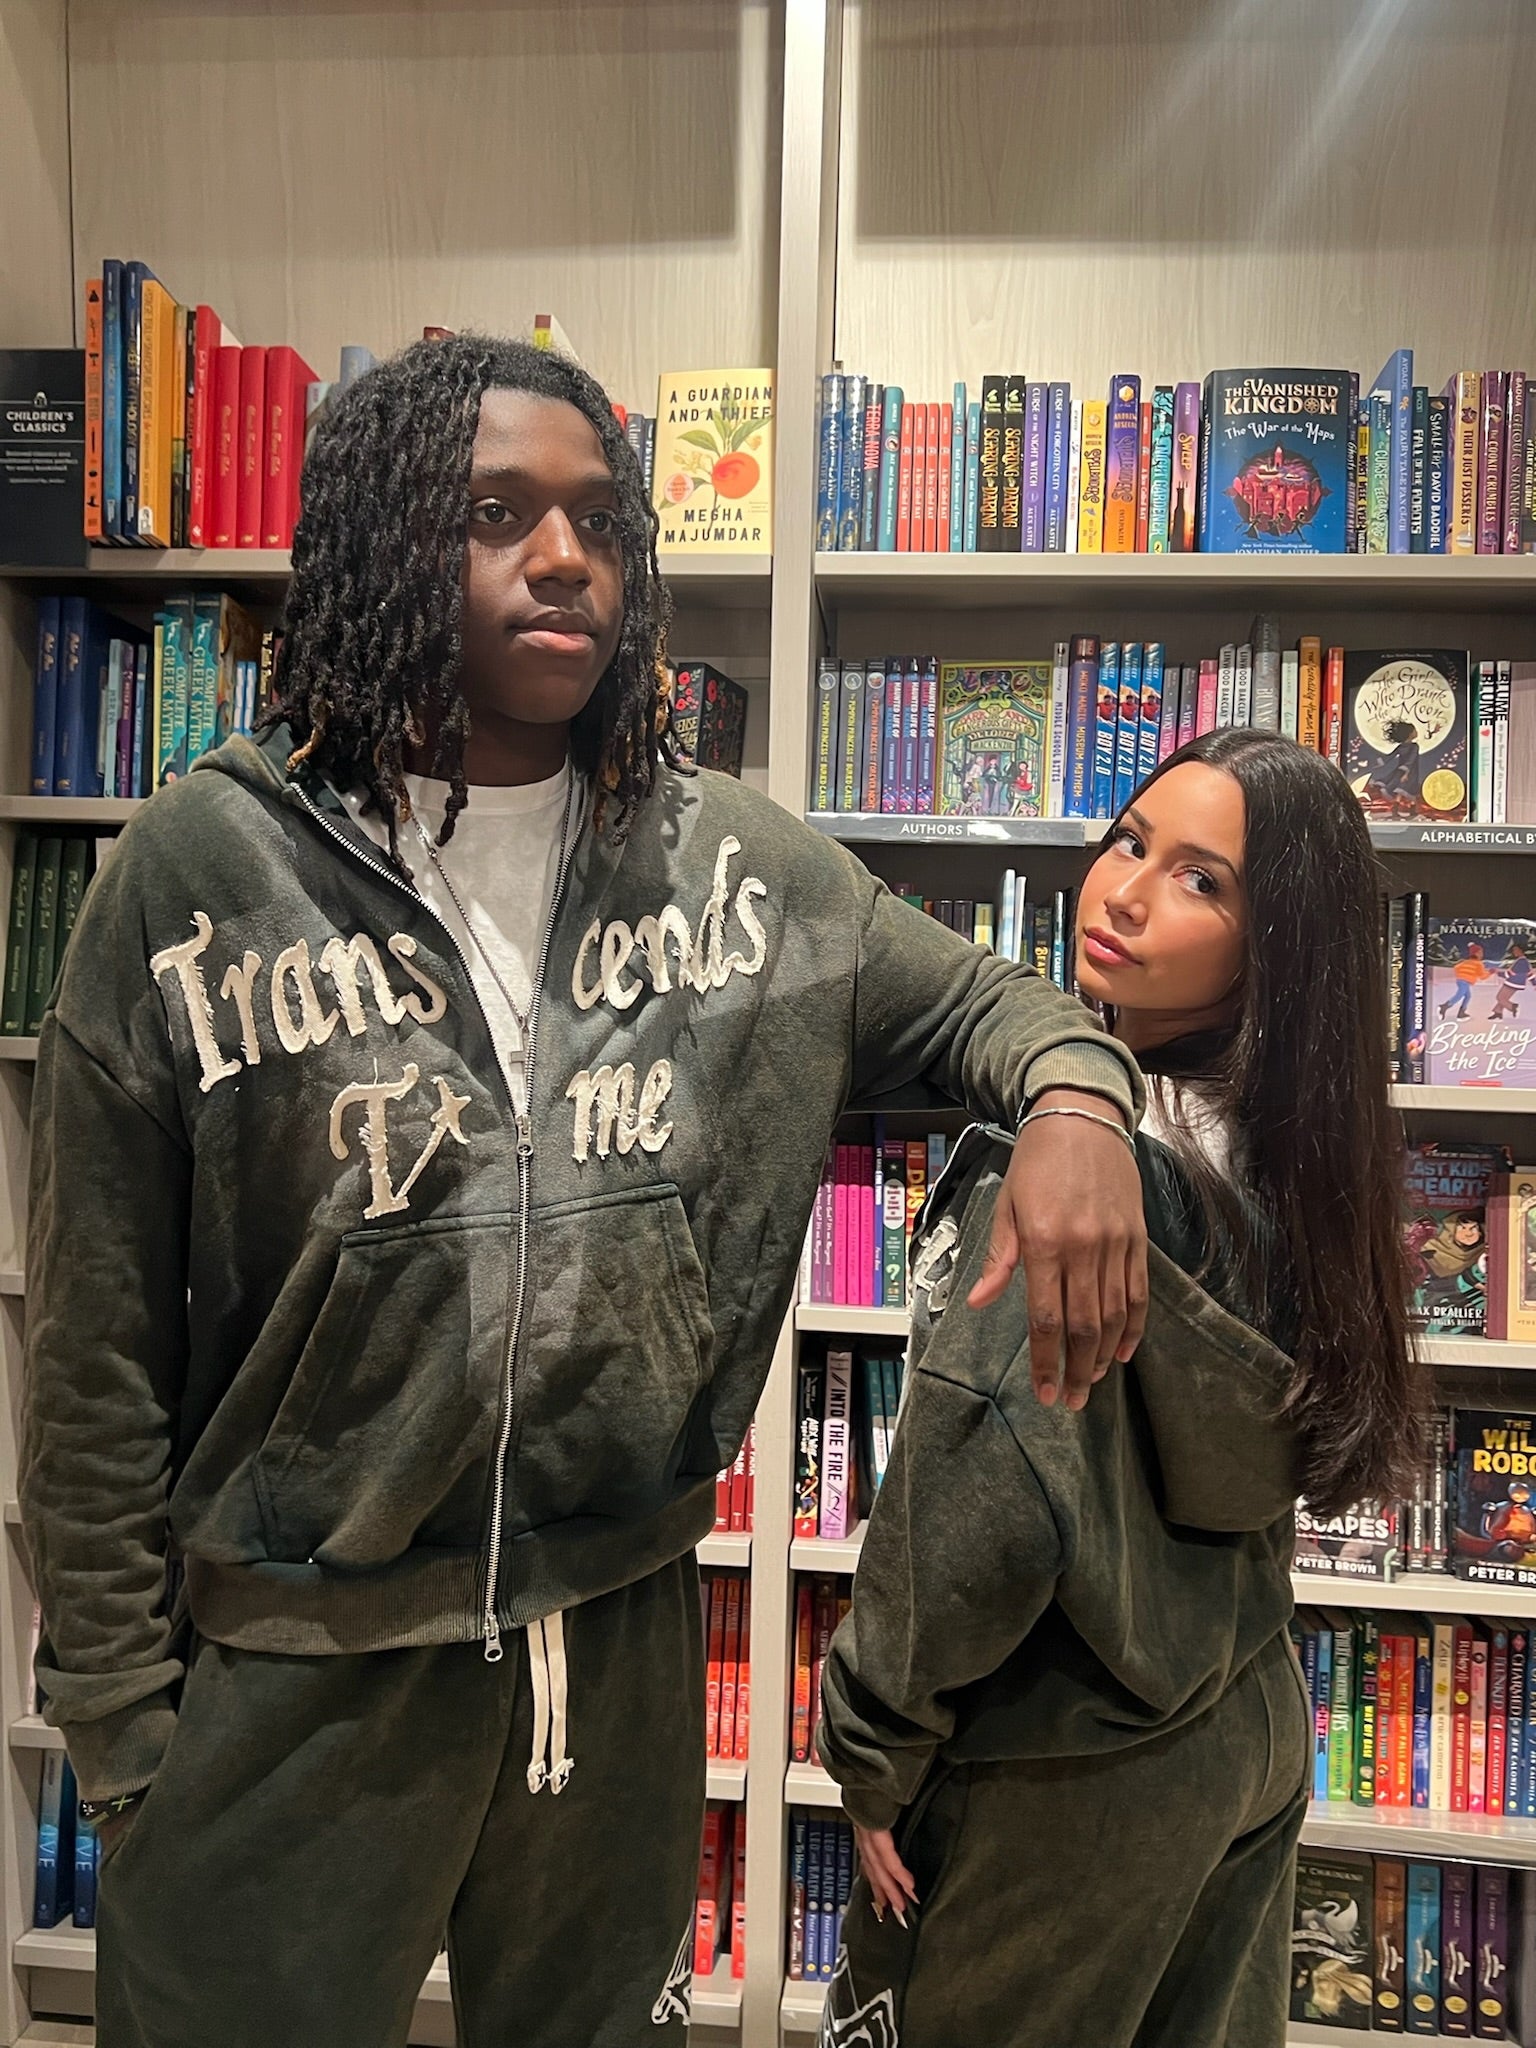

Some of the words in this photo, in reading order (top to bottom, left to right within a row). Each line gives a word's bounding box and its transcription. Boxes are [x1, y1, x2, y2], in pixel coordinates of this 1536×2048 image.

[670, 391, 677, 403] A
[688, 387, 772, 402] GUARDIAN
[1031, 387, 1040, 413] CURSE
[1054, 389, 1063, 411] CURSE
[1224, 387, 1250, 397] THE
[1244, 379, 1339, 397] VANISHED
[6, 411, 74, 421] CHILDREN'S
[669, 409, 699, 423] AND
[706, 408, 715, 421] A
[721, 407, 771, 421] THIEF
[1224, 397, 1337, 415] KINGDOM
[13, 423, 67, 432] CLASSICS
[867, 404, 881, 436] TERRA
[1225, 427, 1246, 440] The
[1248, 421, 1279, 438] War
[1305, 421, 1335, 444] Maps
[1430, 413, 1441, 448] SMALL
[1030, 433, 1039, 458] NIGHT
[1399, 429, 1408, 458] FAIRY
[1412, 429, 1423, 454] FALL
[1463, 430, 1473, 455] THEIR
[1512, 413, 1523, 460] GHOUL
[864, 440, 879, 470] NOVA
[982, 428, 1001, 477] SCARING
[1002, 428, 1021, 477] SCARING
[1053, 431, 1062, 472] FORGOTTEN
[1153, 446, 1167, 476] NIGHT
[1178, 433, 1195, 470] SWEEP
[1374, 450, 1388, 479] CURSE
[1431, 450, 1443, 469] FRY
[1488, 441, 1499, 472] COOKIE
[1029, 460, 1038, 486] WITCH
[1359, 455, 1367, 477] WORST
[1399, 459, 1407, 486] TALE
[1463, 457, 1473, 478] JUST
[1526, 466, 1534, 484] CREEK
[1052, 474, 1061, 490] CITY
[1358, 482, 1367, 501] WEEK
[1431, 471, 1441, 503] DAVID
[1509, 465, 1520, 526] SUMMER
[981, 486, 999, 528] DARING
[1002, 486, 1019, 528] DARING
[1150, 479, 1166, 536] GARDENER
[1374, 487, 1387, 521] EELGRASS
[1461, 481, 1472, 525] DESSERTS
[1486, 475, 1497, 522] CRUMBLES
[1525, 485, 1533, 509] LIBRARY
[684, 505, 744, 523] MEGHA
[1411, 488, 1422, 534] ROBOTS
[664, 528, 761, 543] MAJUMDAR
[1370, 523, 1385, 537] BOG
[1430, 505, 1441, 548] BADDIEL
[163, 645, 176, 695] GREEK
[190, 646, 204, 696] GREEK
[1080, 671, 1088, 692] MOKO
[1221, 651, 1233, 686] LINWOOD
[1239, 651, 1250, 686] LINWOOD
[1374, 672, 1397, 690] The
[1398, 667, 1434, 684] Girl
[175, 666, 186, 728] COMPLETE
[204, 667, 215, 729] COMPLETE
[892, 682, 901, 712] HAUNTED
[910, 682, 918, 712] HAUNTED
[927, 682, 936, 712] HAUNTED
[1077, 696, 1088, 722] MAGIC
[1219, 688, 1232, 718] BARCLAY
[1237, 689, 1247, 719] BARCLAY
[1358, 689, 1395, 714] Who
[1398, 684, 1450, 708] Drank
[1480, 673, 1495, 728] BLUME
[1496, 670, 1511, 722] BLUME
[161, 699, 175, 749] MYTHS
[189, 700, 204, 750] MYTHS
[892, 713, 900, 727] LIFE
[927, 713, 935, 727] LIFE
[1054, 702, 1063, 729] MIDDLE
[1368, 709, 1390, 722] the
[1393, 700, 1449, 723] Moon
[820, 727, 829, 755] PRINCESS
[847, 727, 855, 755] PRINCESS
[892, 729, 900, 738] OF
[910, 729, 917, 738] OF
[927, 729, 934, 738] OF
[1053, 731, 1062, 757] SCHOOL
[1076, 726, 1087, 760] MUSEUM
[1097, 731, 1112, 754] BOY
[1119, 731, 1134, 754] BOY
[1141, 731, 1156, 754] BOY
[819, 763, 827, 784] BURIED
[845, 763, 854, 784] BURIED
[1052, 760, 1061, 782] BITES
[1096, 754, 1111, 776] 2.0
[1118, 754, 1133, 776] 2.0
[1139, 754, 1154, 777] 2.0
[1073, 763, 1083, 797] MAYHEM
[818, 785, 827, 809] CASTLE
[844, 785, 853, 809] CASTLE
[868, 790, 876, 809] NIGHT
[900, 823, 962, 835] AUTHORS
[1421, 832, 1522, 844] ALPHABETICAL
[1440, 924, 1494, 935] NATALIE
[1497, 925, 1532, 935] BLITT
[1416, 933, 1424, 962] GHOST
[150, 910, 447, 1093] Trans
[571, 834, 768, 1010] cends
[1415, 963, 1423, 998] SCOUT'S
[1415, 999, 1423, 1030] HONOR
[1425, 1022, 1536, 1057] Breaking
[1445, 1052, 1479, 1072] the
[1478, 1050, 1517, 1079] Ice
[566, 1058, 674, 1163] me
[1450, 1161, 1493, 1175] KIDS
[1433, 1306, 1483, 1319] BRALLIER
[830, 1389, 846, 1417] INTO
[829, 1423, 844, 1446] THE
[1504, 1419, 1532, 1430] THE
[1482, 1429, 1536, 1453] WIL
[828, 1452, 843, 1481] FIRE
[1473, 1449, 1536, 1476] ROB
[1296, 1556, 1332, 1569] PETER
[1334, 1561, 1377, 1574] BROWN
[1468, 1566, 1514, 1582] PETER
[1457, 1640, 1470, 1672] Ripley
[1510, 1653, 1524, 1715] CHARMED
[1364, 1706, 1374, 1720] WAY
[1493, 1735, 1502, 1751] JEN
[1511, 1737, 1520, 1753] JEN
[1398, 1761, 1407, 1785] AGAIN
[1455, 1748, 1464, 1787] cameron
[1491, 1753, 1501, 1794] CALONITA
[1509, 1755, 1519, 1797] CALONITA
[1528, 1766, 1536, 1801] CALONITA
